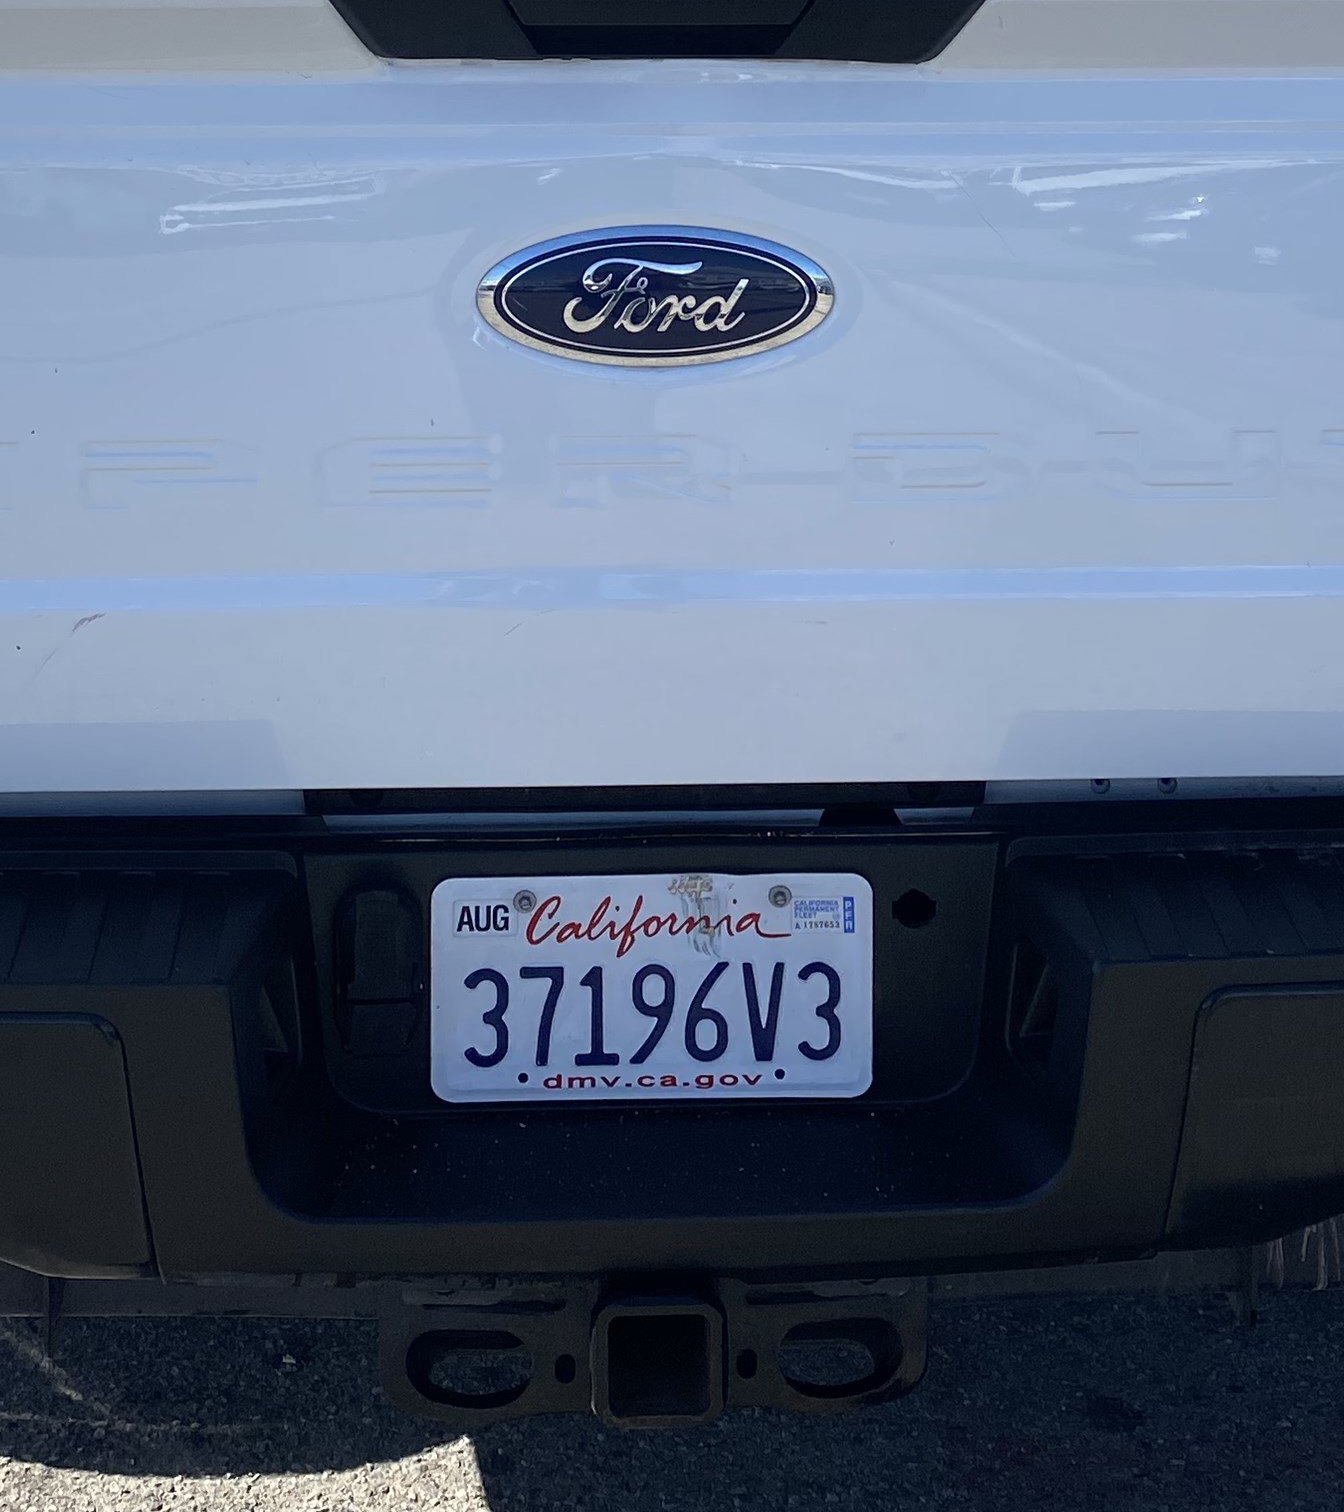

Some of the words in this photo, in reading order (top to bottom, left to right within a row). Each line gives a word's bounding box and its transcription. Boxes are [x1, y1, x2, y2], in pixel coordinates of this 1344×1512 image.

[563, 257, 750, 333] Ford
[456, 904, 510, 933] AUG
[524, 894, 792, 958] California
[463, 961, 842, 1068] 37196V3
[542, 1072, 763, 1089] dmv.ca.gov
